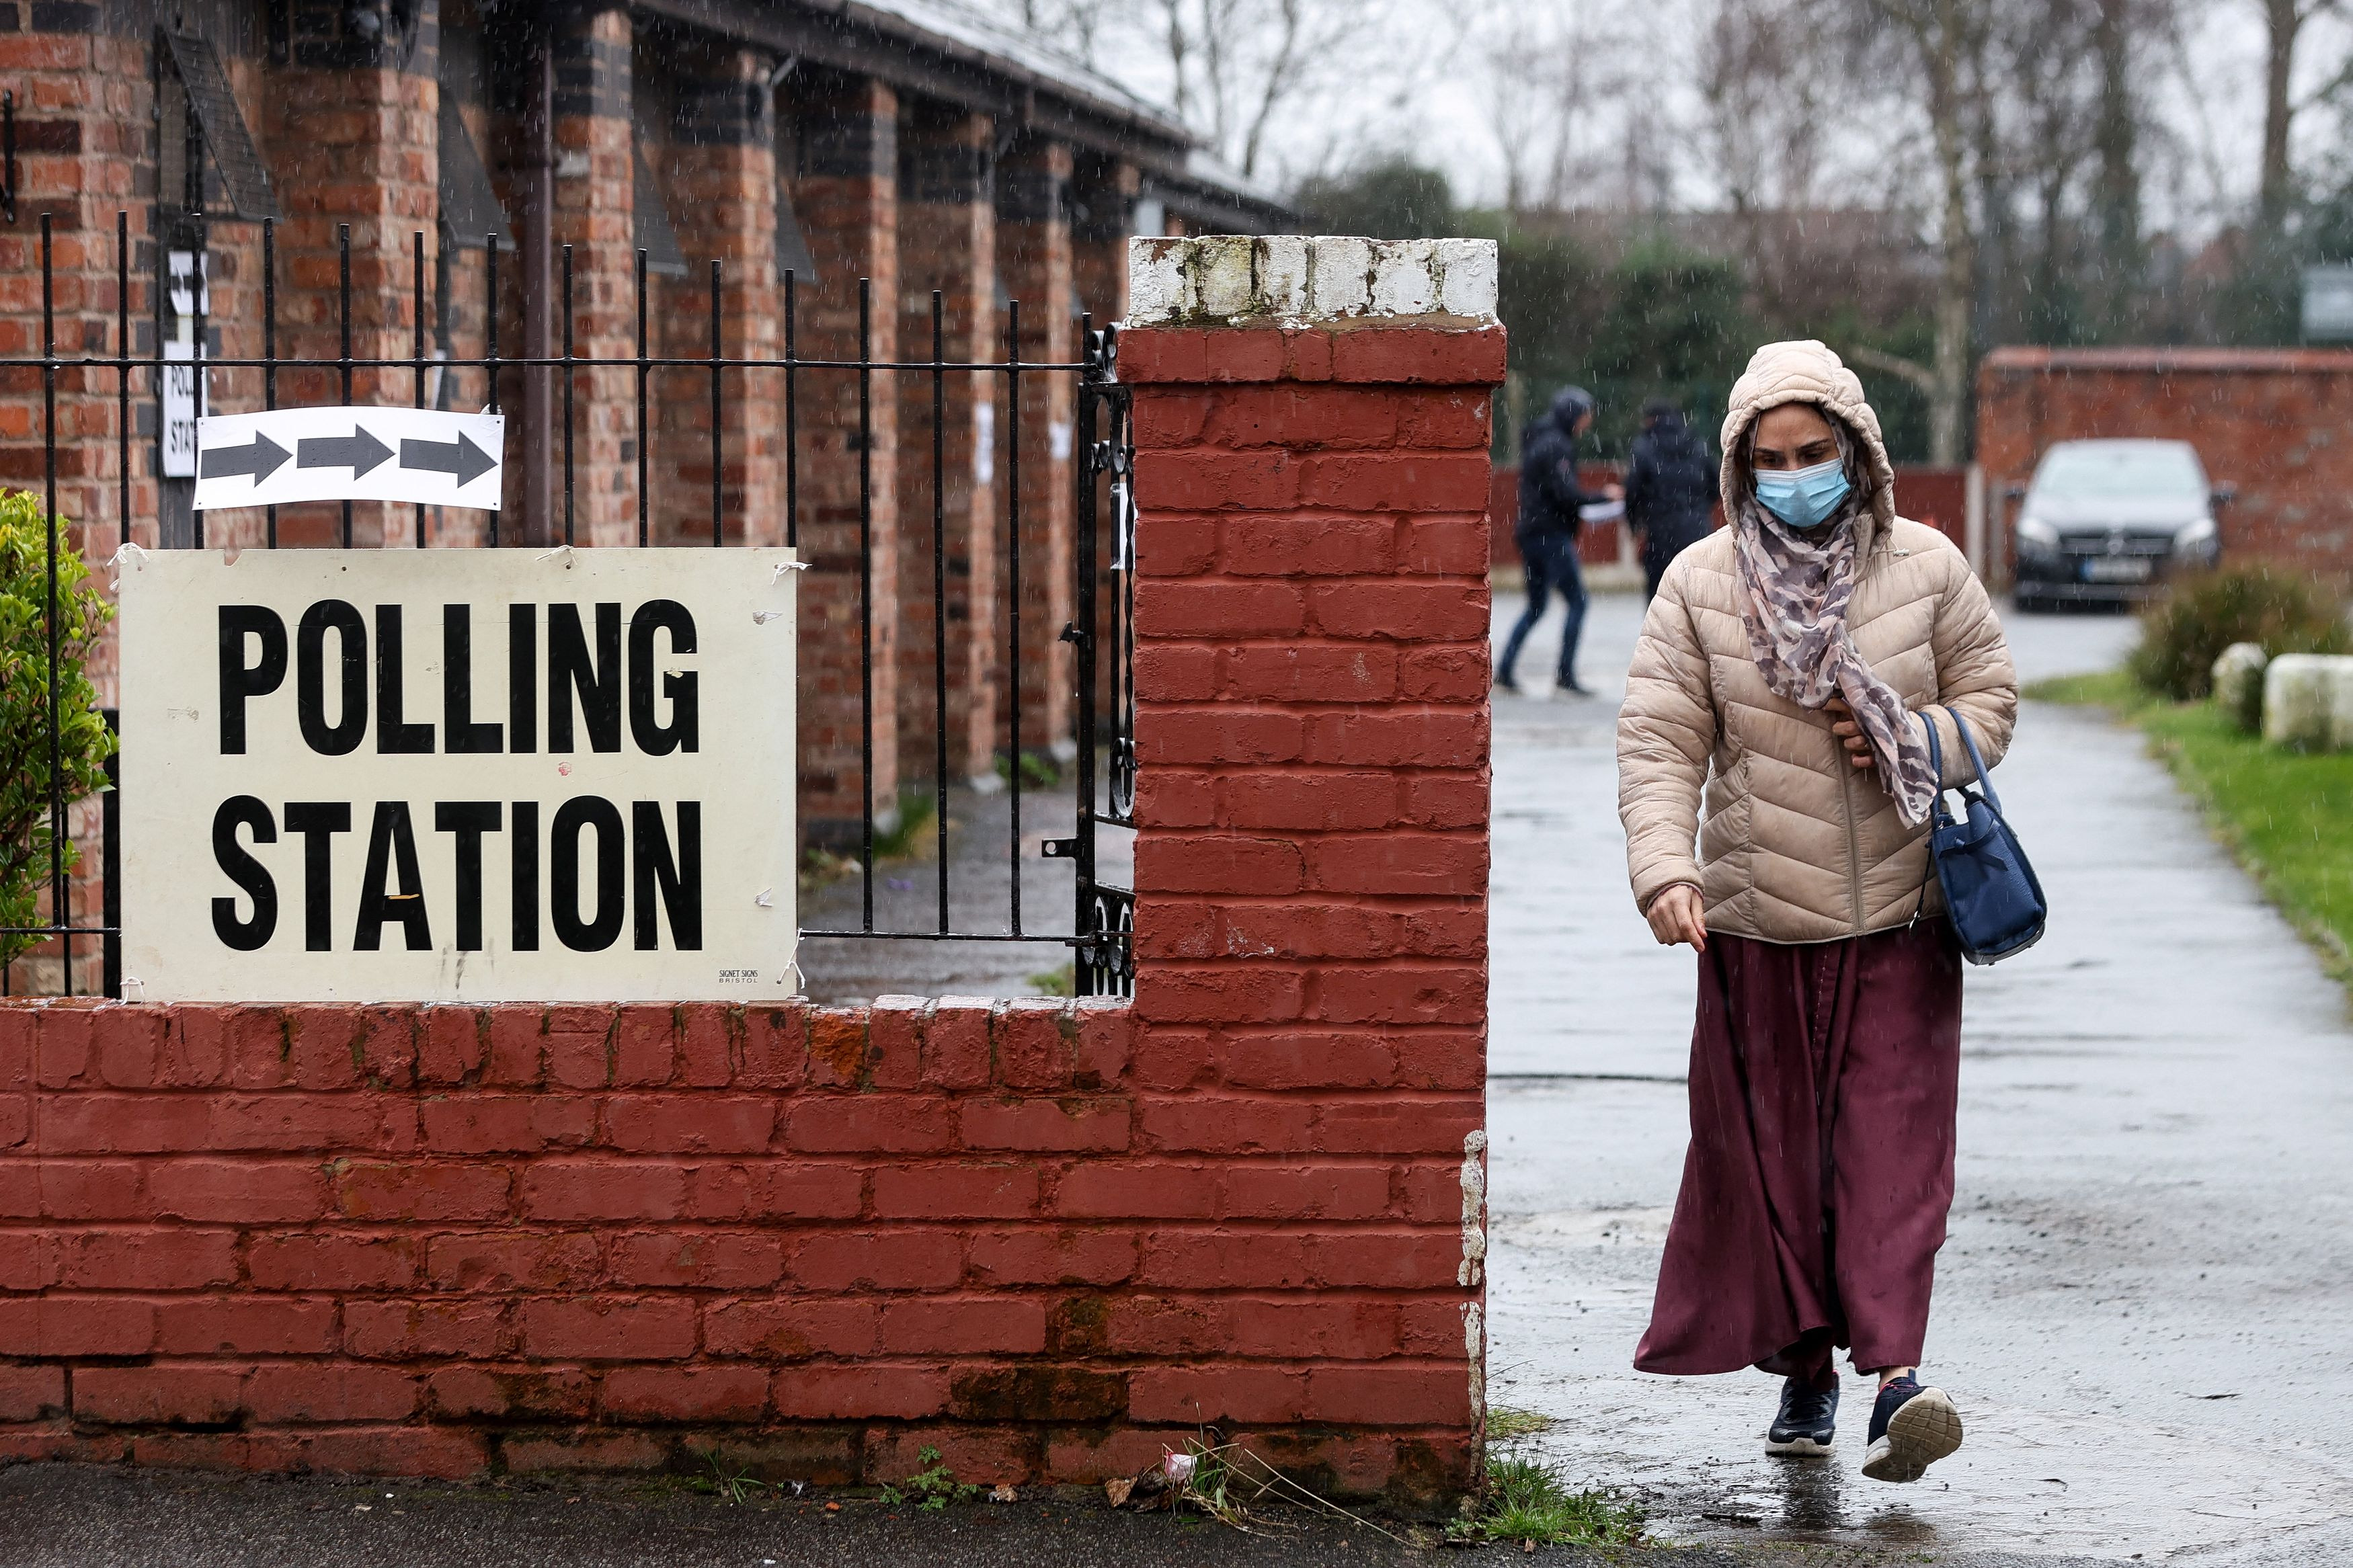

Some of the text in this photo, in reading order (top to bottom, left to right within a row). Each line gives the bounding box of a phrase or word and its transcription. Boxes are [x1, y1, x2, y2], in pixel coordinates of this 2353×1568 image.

[171, 366, 194, 397] POLL
[219, 599, 699, 757] POLLING
[211, 794, 703, 952] STATION
